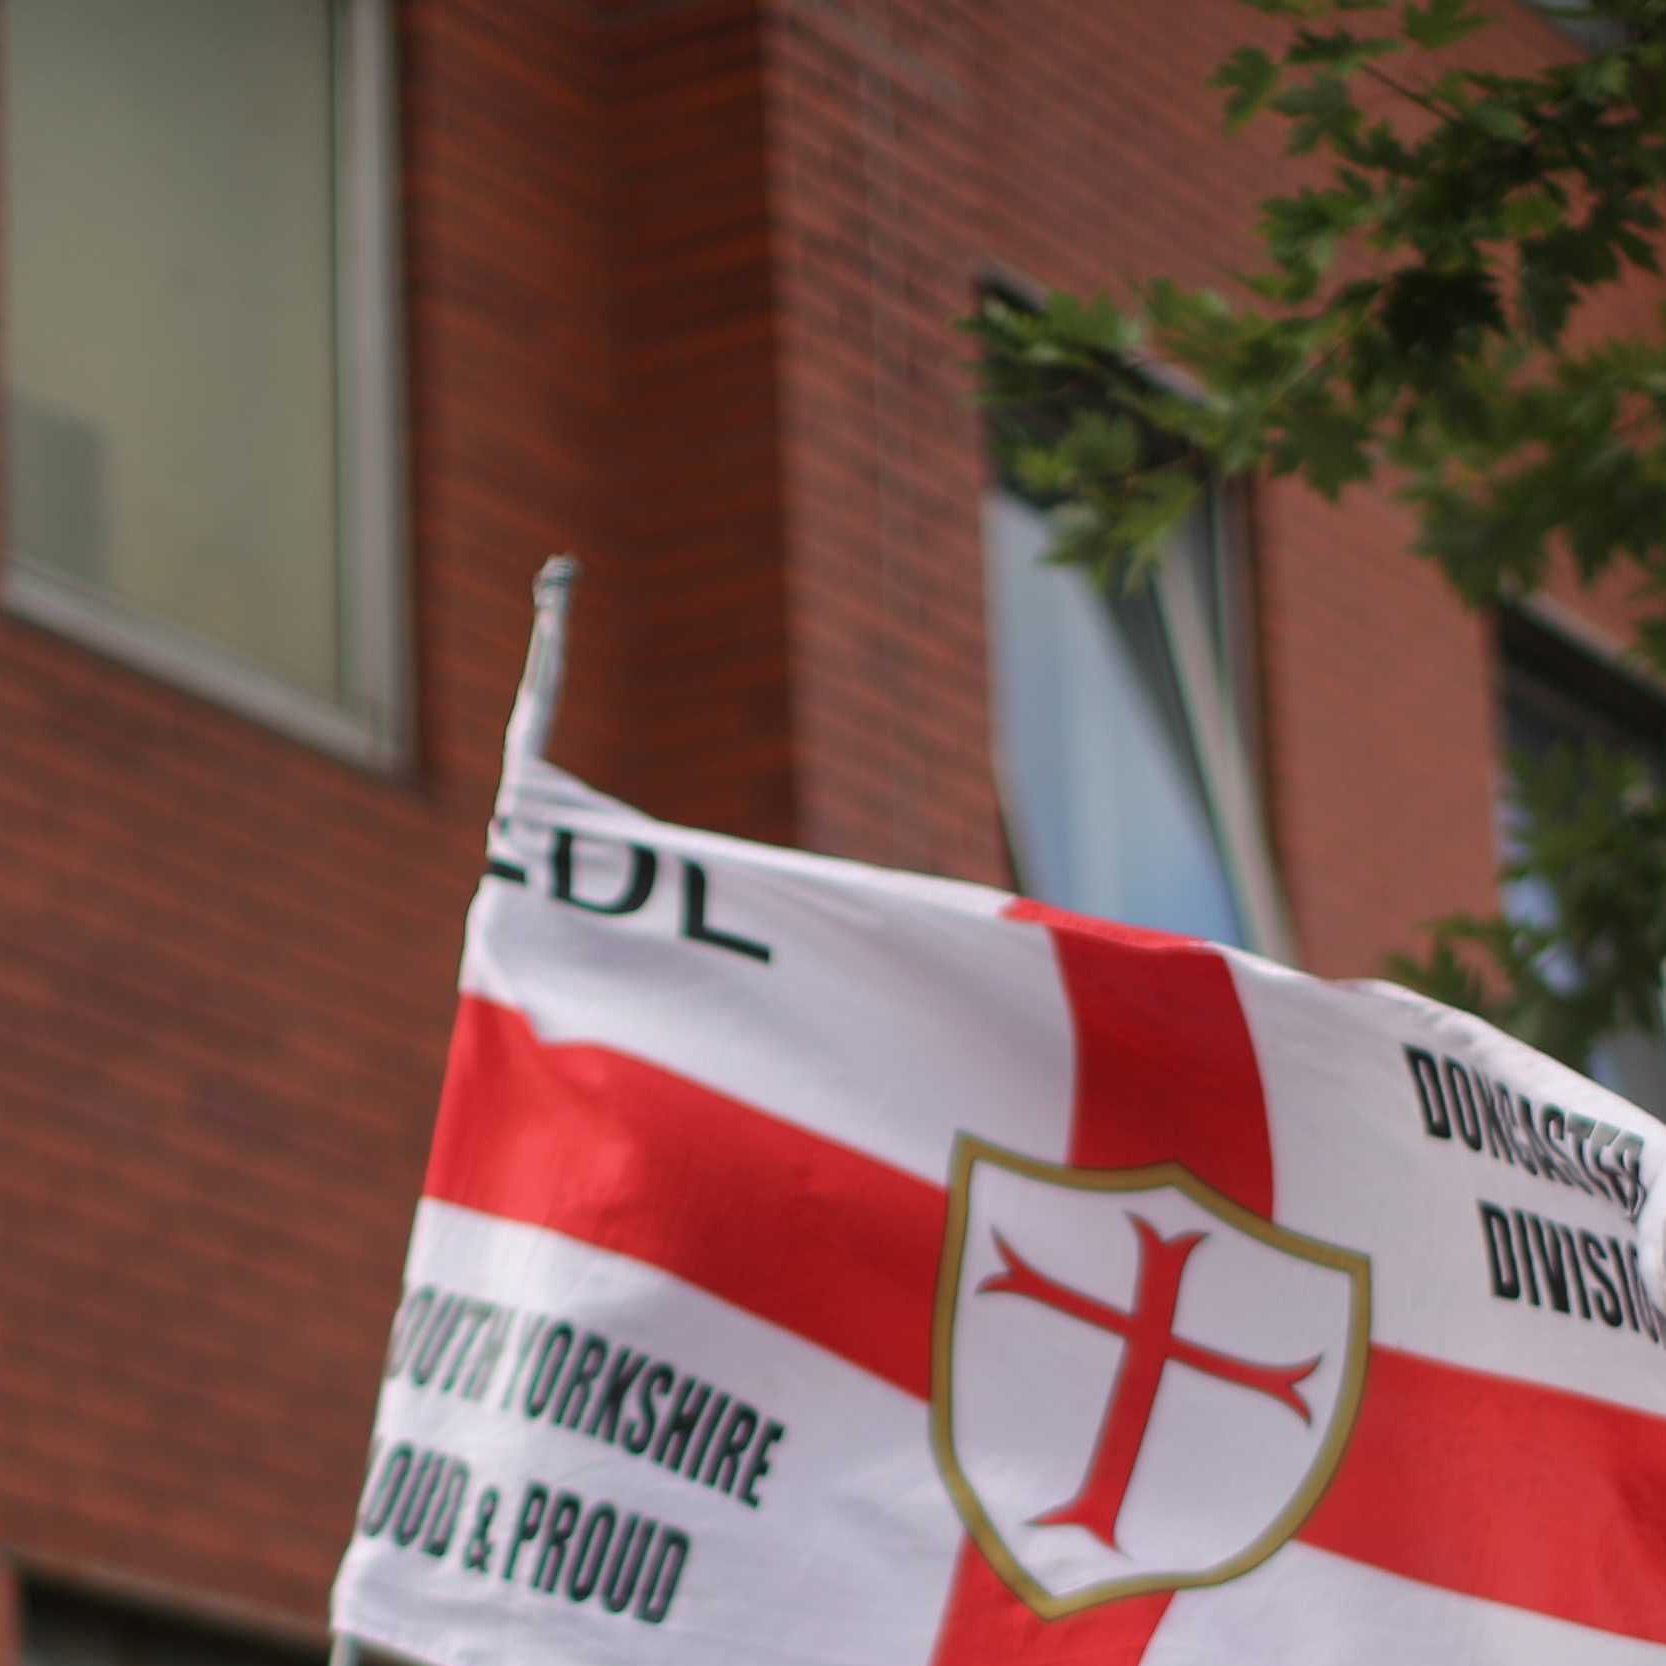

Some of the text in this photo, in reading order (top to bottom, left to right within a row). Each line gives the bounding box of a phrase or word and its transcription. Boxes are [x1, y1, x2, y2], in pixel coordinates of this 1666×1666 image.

[386, 1282, 786, 1509] OUTH YORKSHIRE
[363, 1442, 691, 1625] OUD & PROUD
